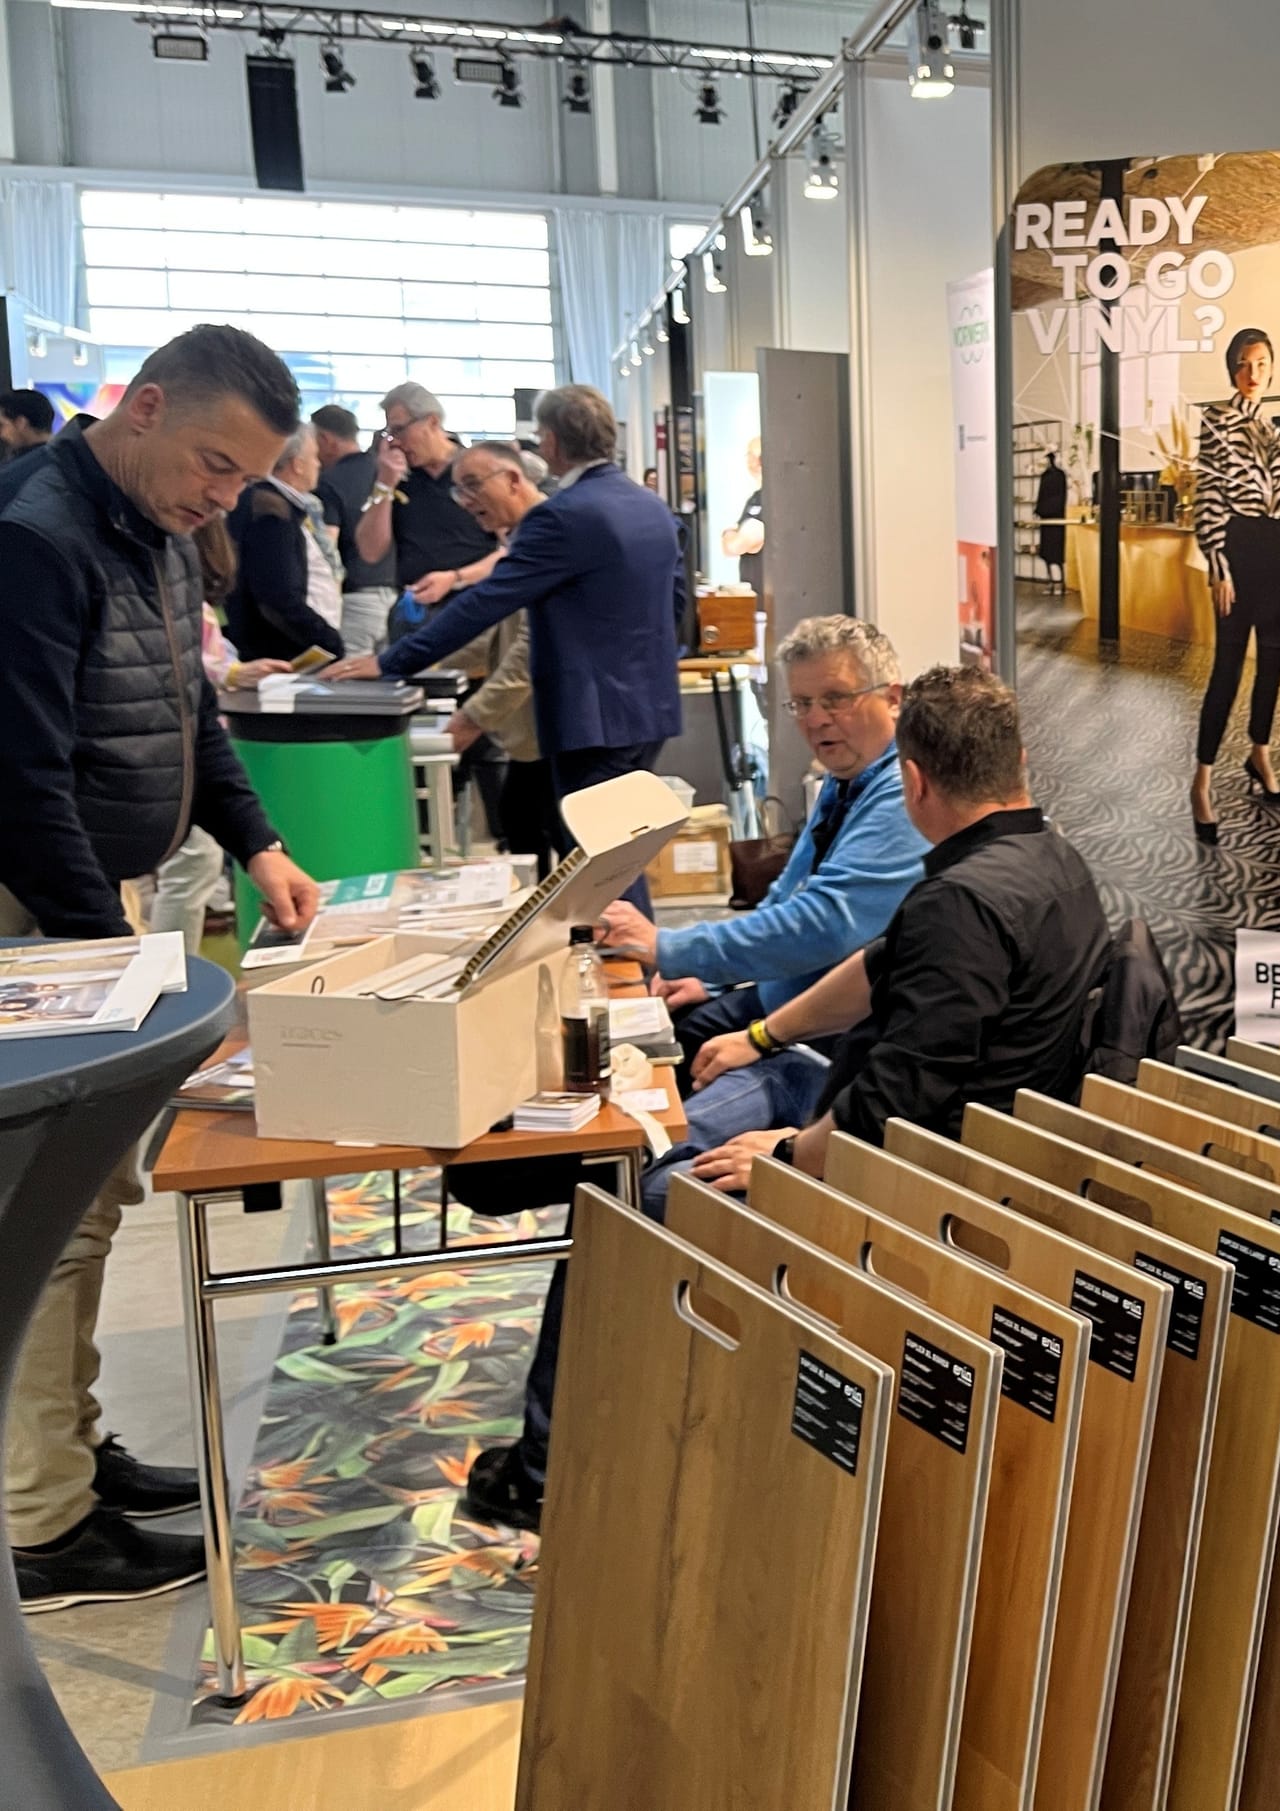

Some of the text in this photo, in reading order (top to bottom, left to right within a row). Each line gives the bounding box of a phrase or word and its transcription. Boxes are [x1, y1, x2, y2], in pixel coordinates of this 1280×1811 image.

[1014, 195, 1208, 250] READY
[1051, 250, 1235, 301] TO GO
[1026, 304, 1225, 354] VINYL?
